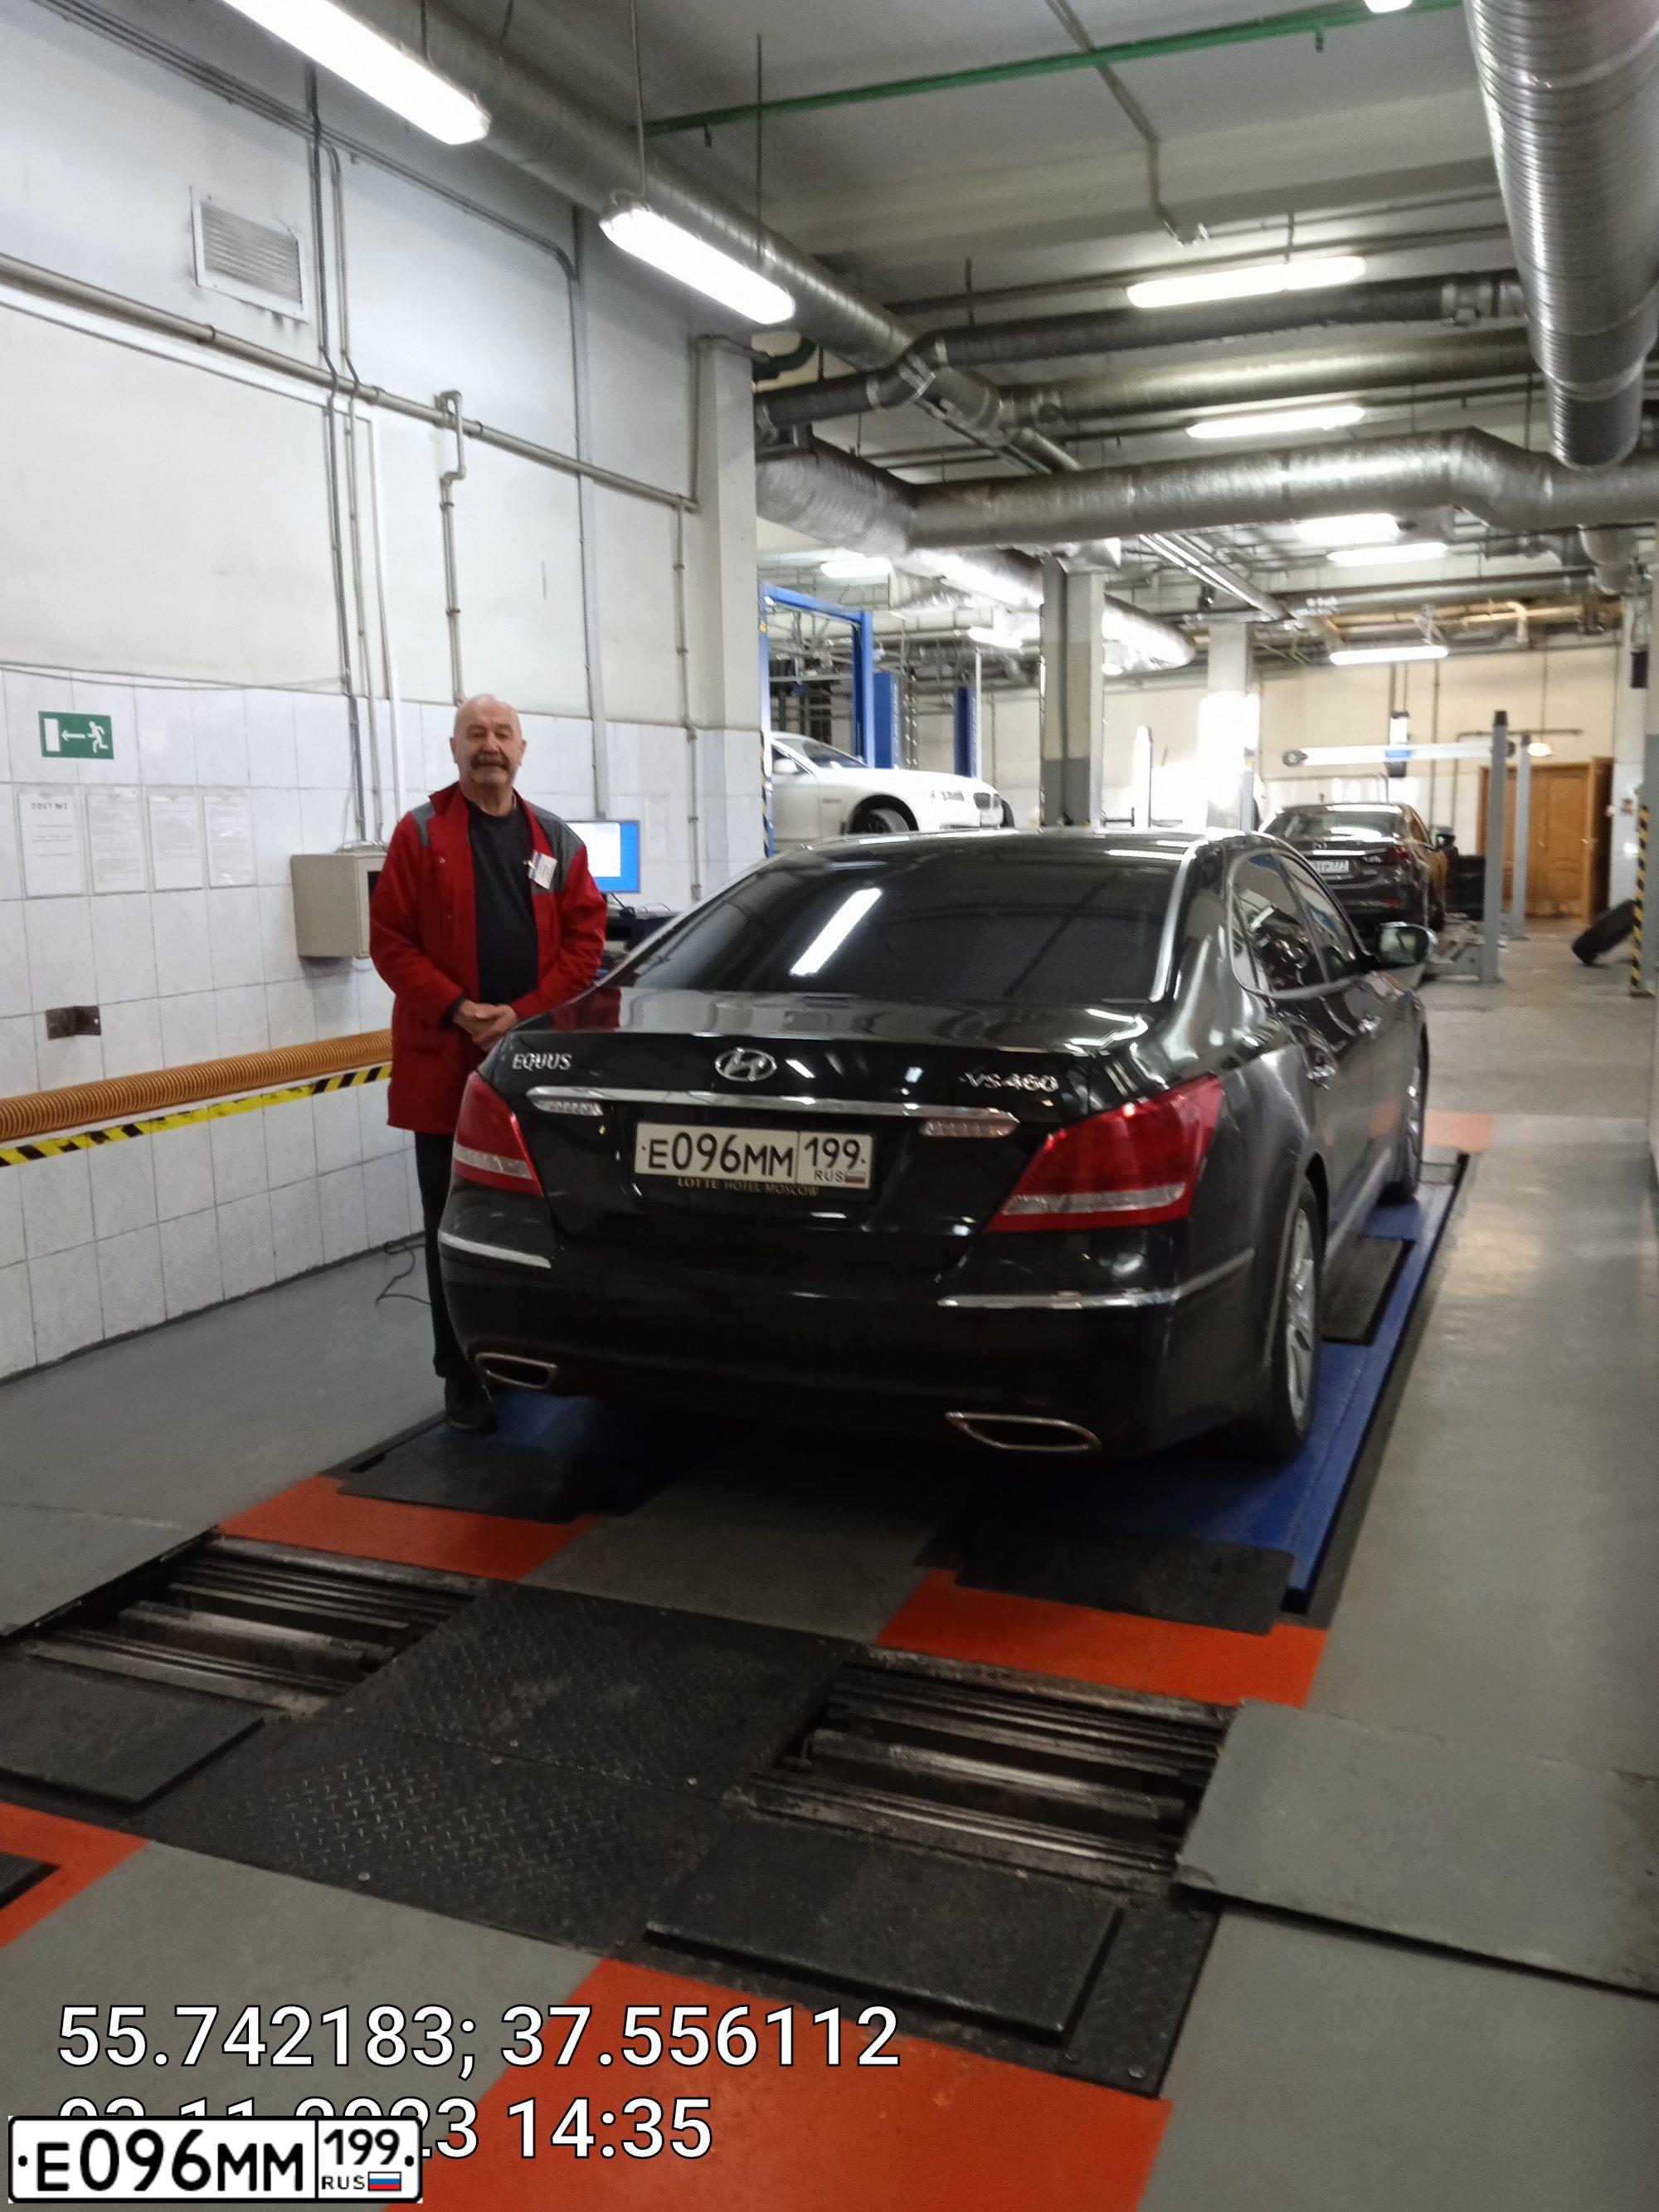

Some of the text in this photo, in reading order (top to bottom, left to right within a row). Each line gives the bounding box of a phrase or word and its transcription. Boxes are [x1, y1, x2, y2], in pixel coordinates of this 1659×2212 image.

[512, 1052, 572, 1070] EQUUS
[648, 1131, 861, 1177] Е096ММ 199
[814, 1169, 844, 1182] RUS
[677, 1177, 820, 1196] LOTTE HOTEL MOSCOW
